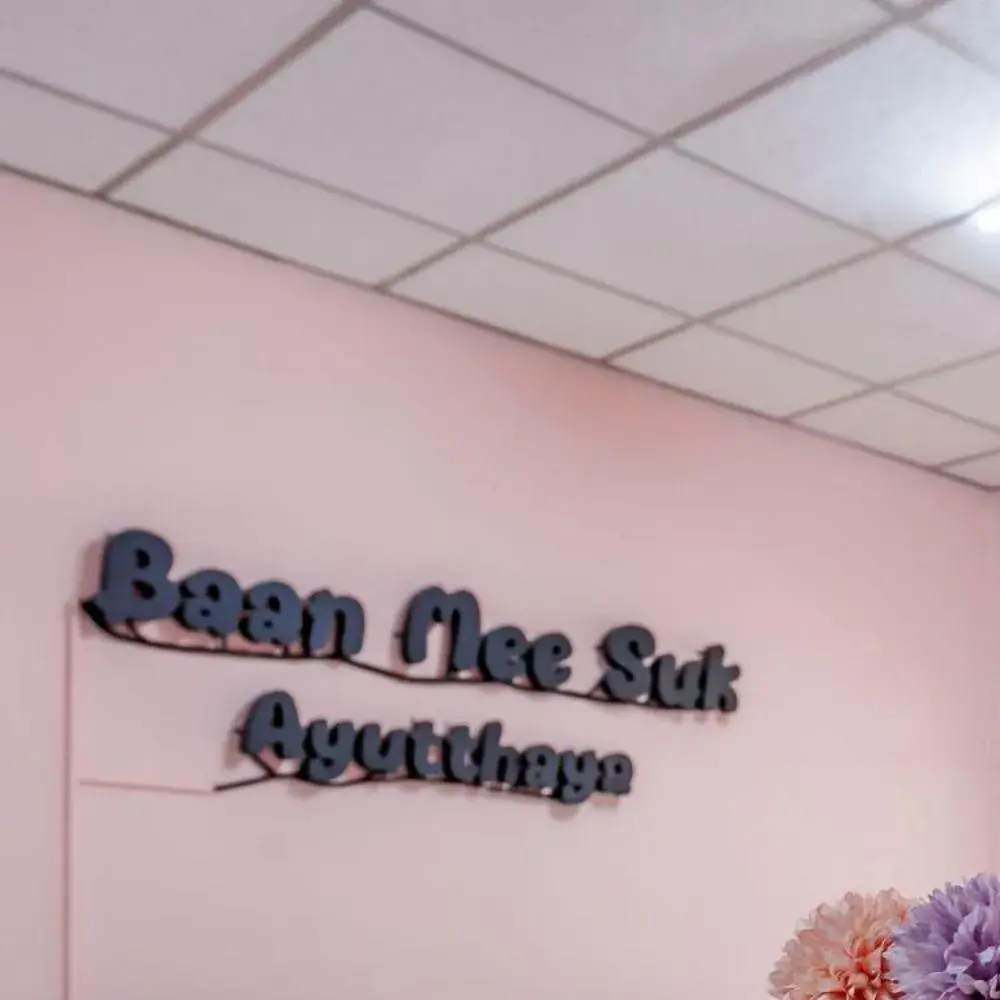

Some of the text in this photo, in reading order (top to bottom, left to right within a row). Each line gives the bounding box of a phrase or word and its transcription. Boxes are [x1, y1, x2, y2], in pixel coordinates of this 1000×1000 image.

[88, 529, 741, 712] Baan Mee Suk
[241, 690, 634, 804] Ayutthaya
